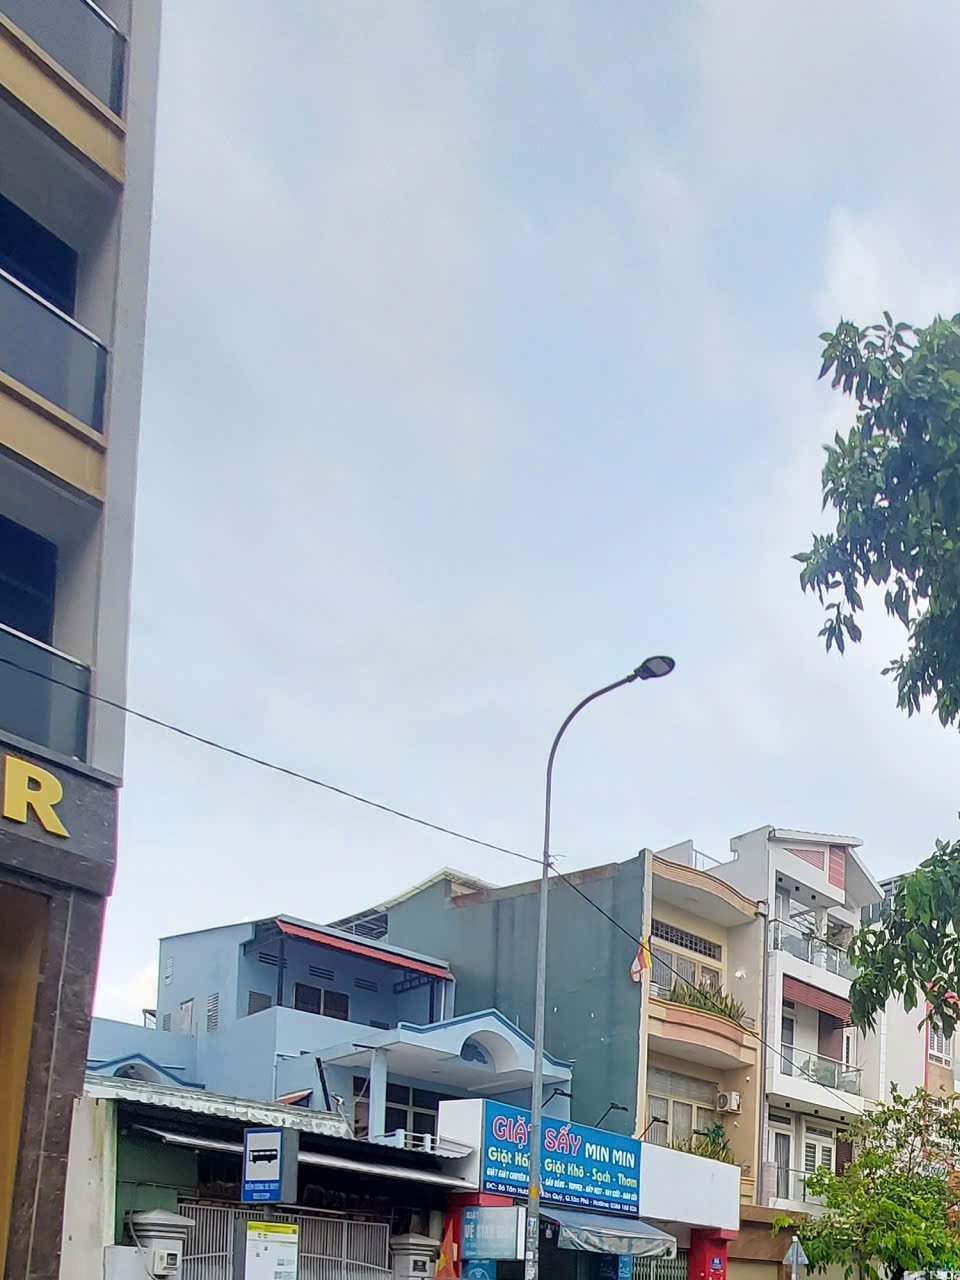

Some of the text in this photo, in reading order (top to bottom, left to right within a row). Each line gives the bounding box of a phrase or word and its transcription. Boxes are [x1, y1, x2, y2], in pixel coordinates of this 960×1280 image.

[493, 1115, 635, 1169] GIẶ SẤY MIN MIN
[488, 1146, 512, 1167] Giặt
[544, 1158, 565, 1177] Giặt
[567, 1162, 584, 1178] Khô
[592, 1167, 611, 1185] Sạch
[617, 1173, 638, 1188] Thơm
